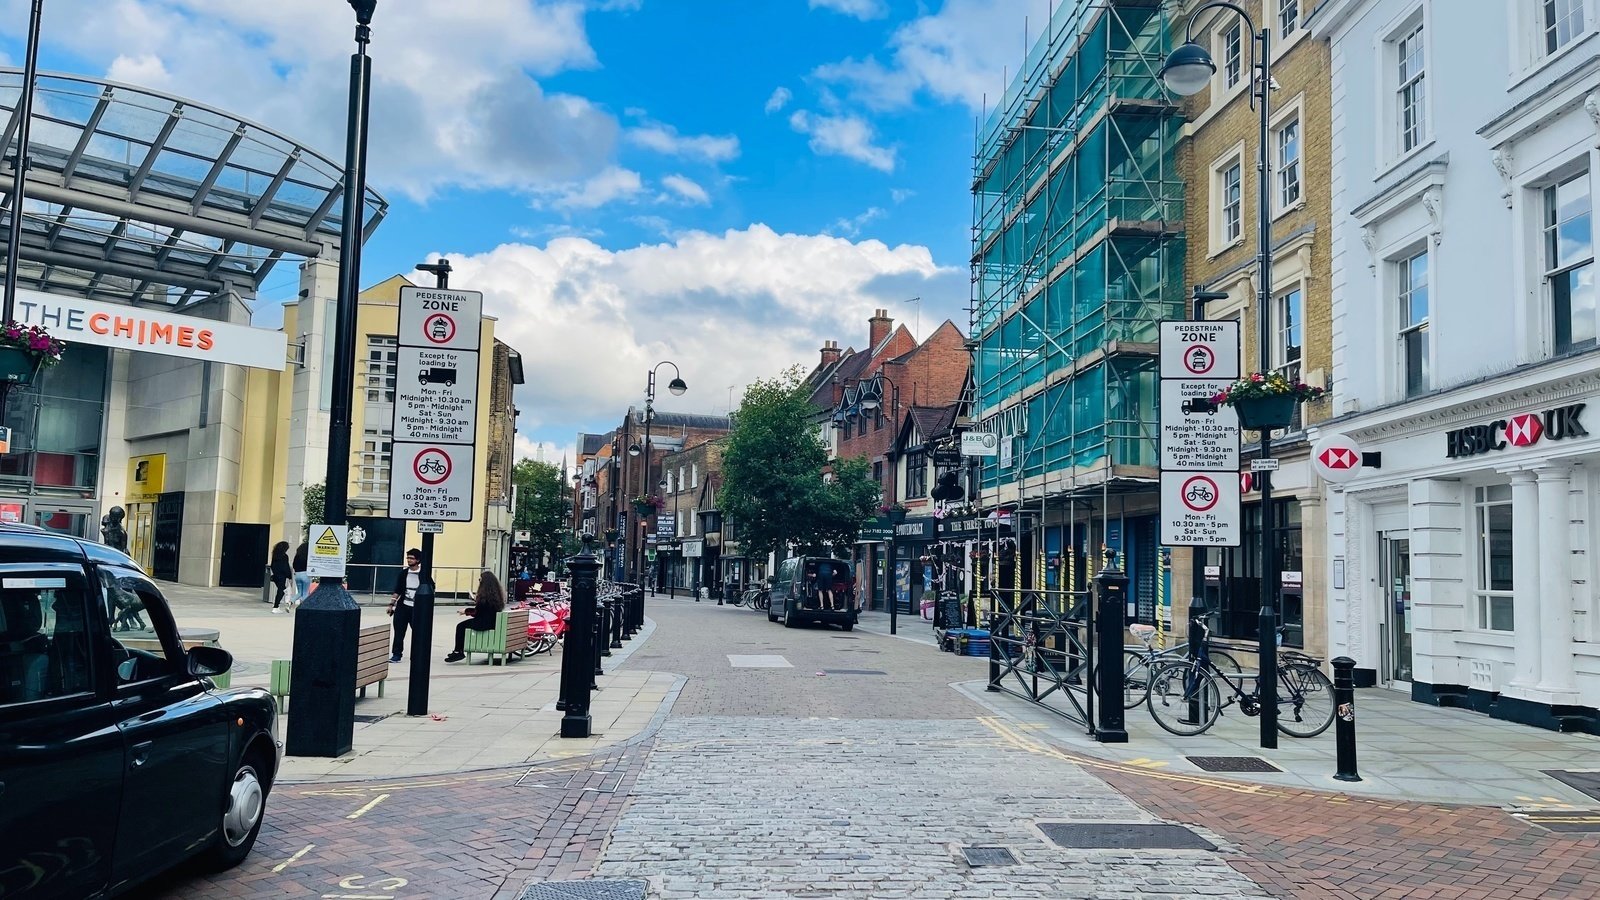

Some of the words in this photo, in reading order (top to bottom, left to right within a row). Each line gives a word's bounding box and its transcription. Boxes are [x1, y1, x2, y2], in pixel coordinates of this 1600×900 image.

[416, 292, 466, 301] PEDESTRIAN
[422, 301, 458, 311] ZONE
[19, 302, 84, 331] THE
[89, 313, 214, 350] CHIMES
[1182, 333, 1216, 341] ZONE
[420, 352, 444, 360] Except
[401, 394, 432, 402] Midnight
[1446, 420, 1507, 458] HSBC
[1542, 403, 1589, 440] UK
[951, 521, 962, 531] THE
